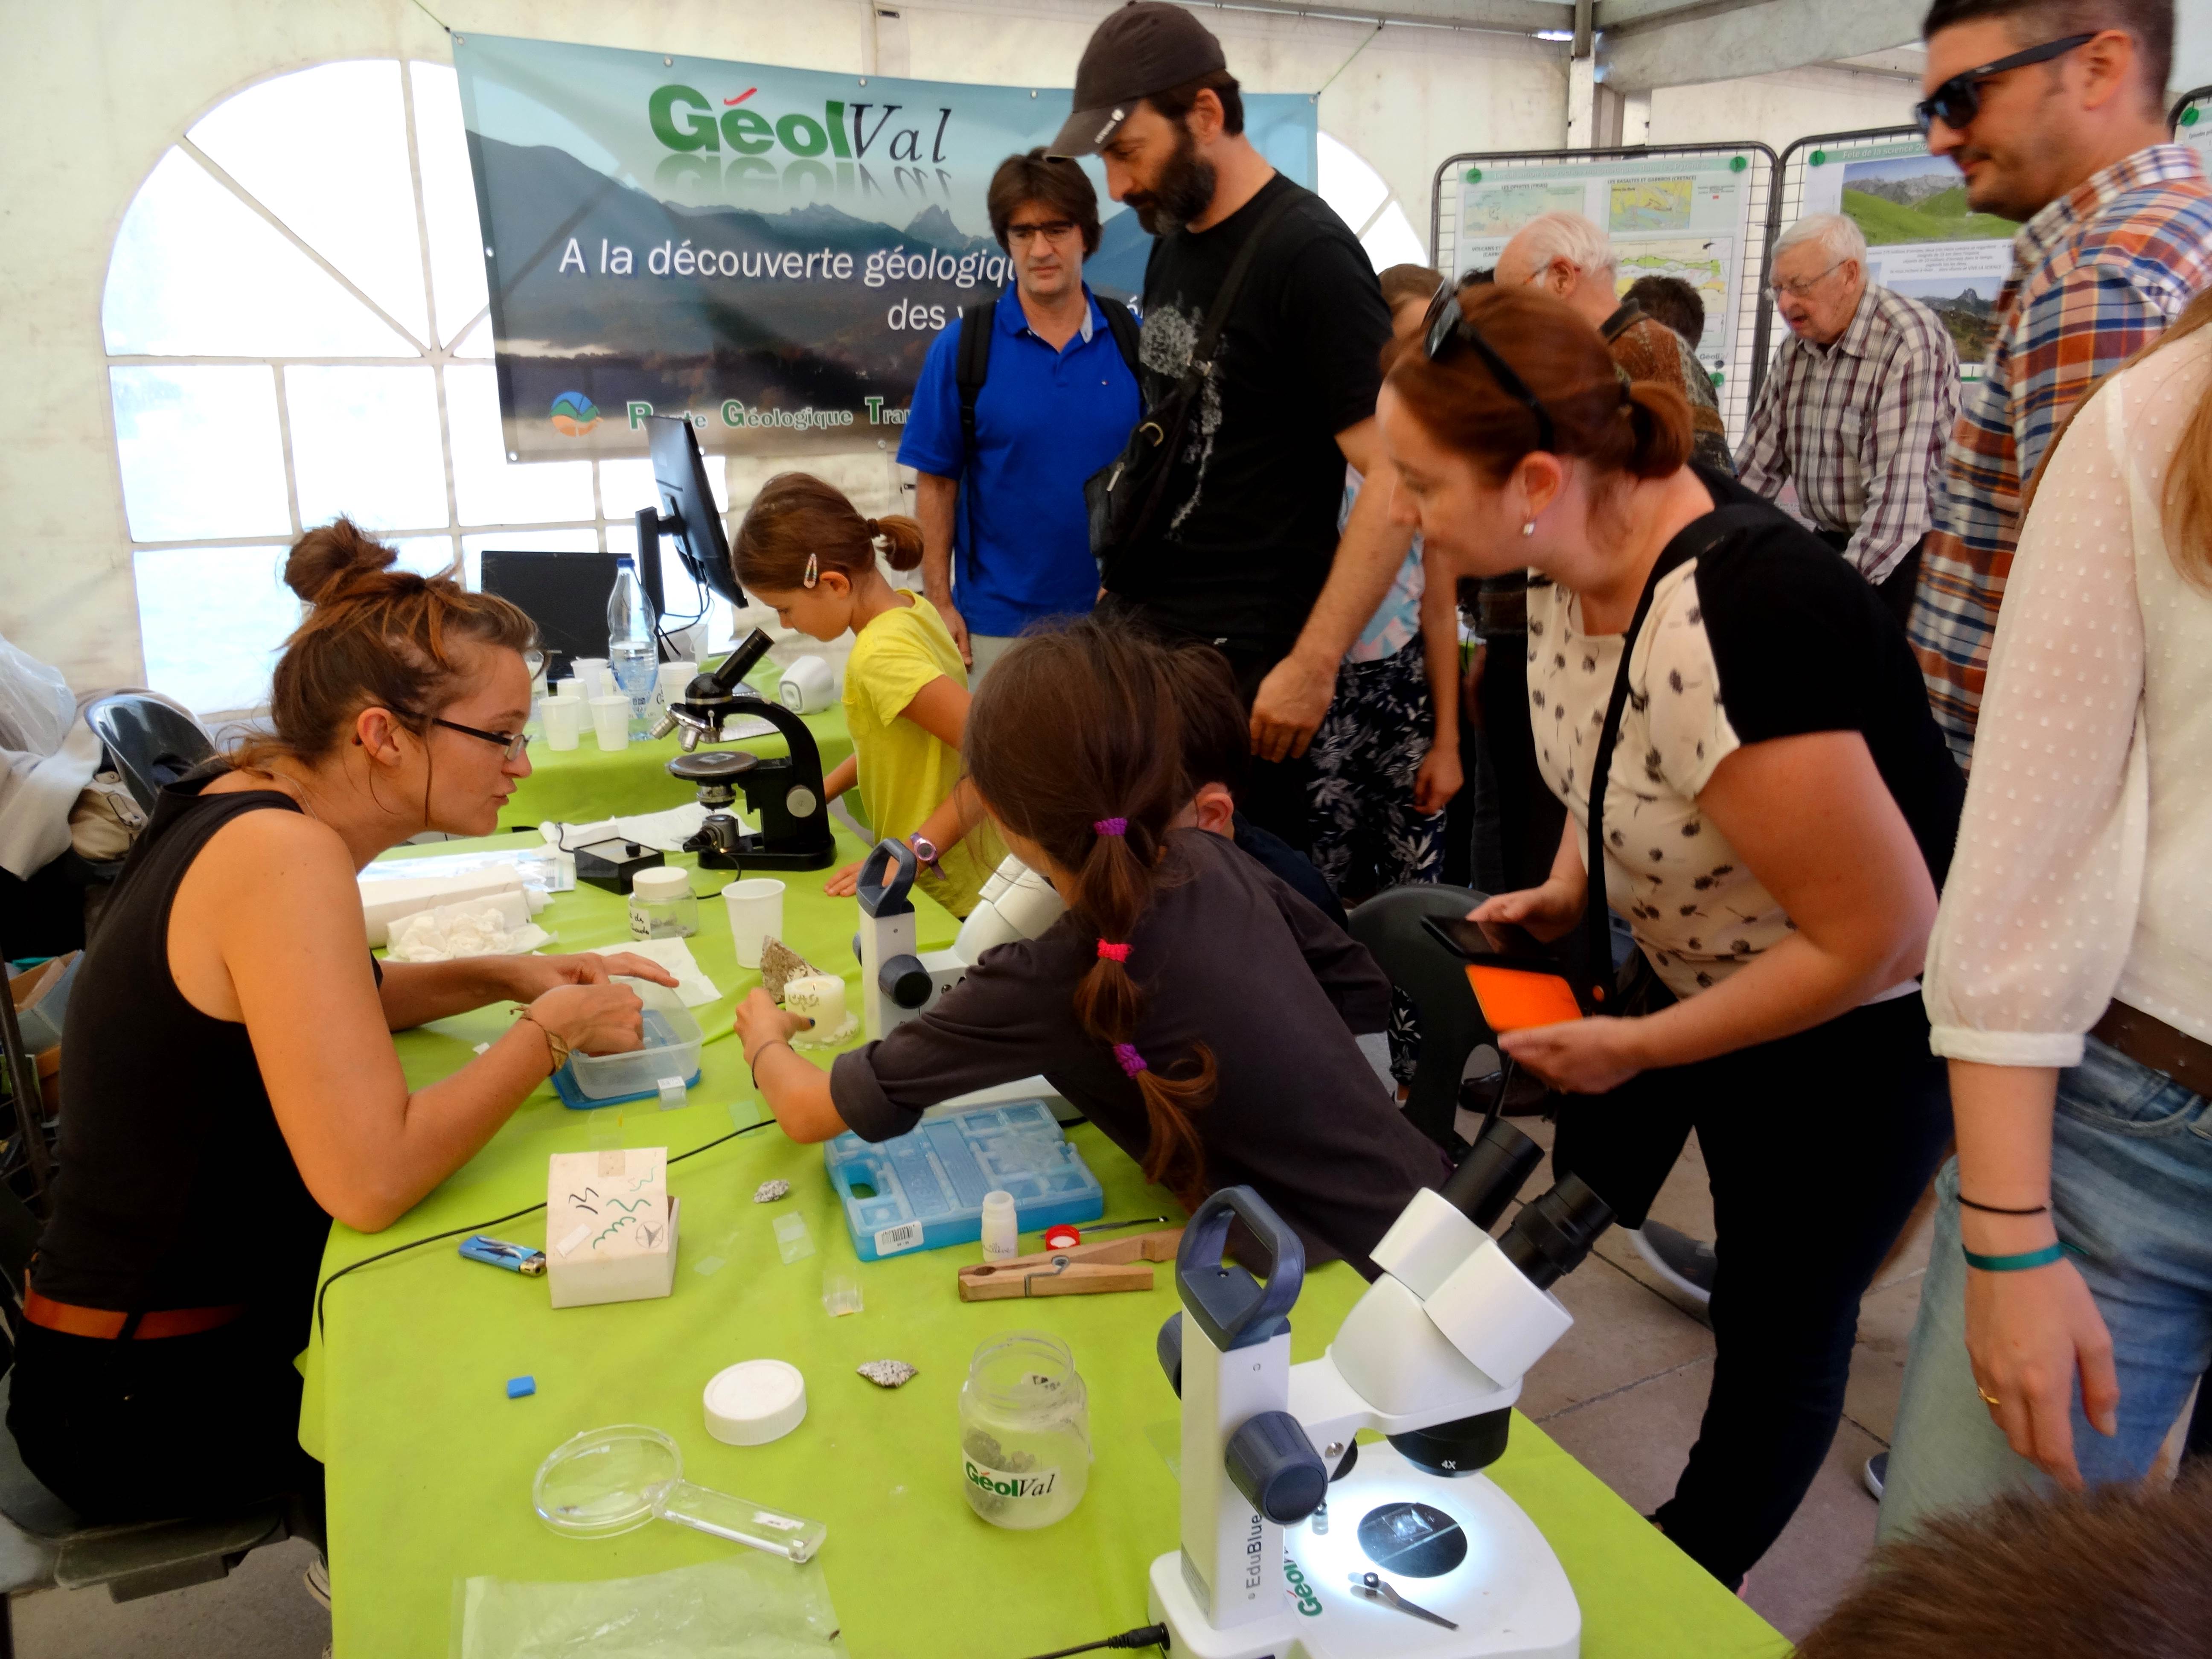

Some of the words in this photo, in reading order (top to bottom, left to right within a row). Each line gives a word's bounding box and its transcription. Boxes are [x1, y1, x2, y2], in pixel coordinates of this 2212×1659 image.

[649, 84, 952, 163] GéolVal
[559, 239, 585, 273] A
[601, 239, 633, 274] la
[648, 240, 853, 280] découverte
[888, 298, 945, 330] des
[721, 399, 853, 431] Géologique
[966, 1461, 1056, 1497] GéolVal
[1441, 1460, 1456, 1470] 4X
[1246, 1514, 1262, 1589] EduBlue
[1284, 1546, 1323, 1617] Géol
